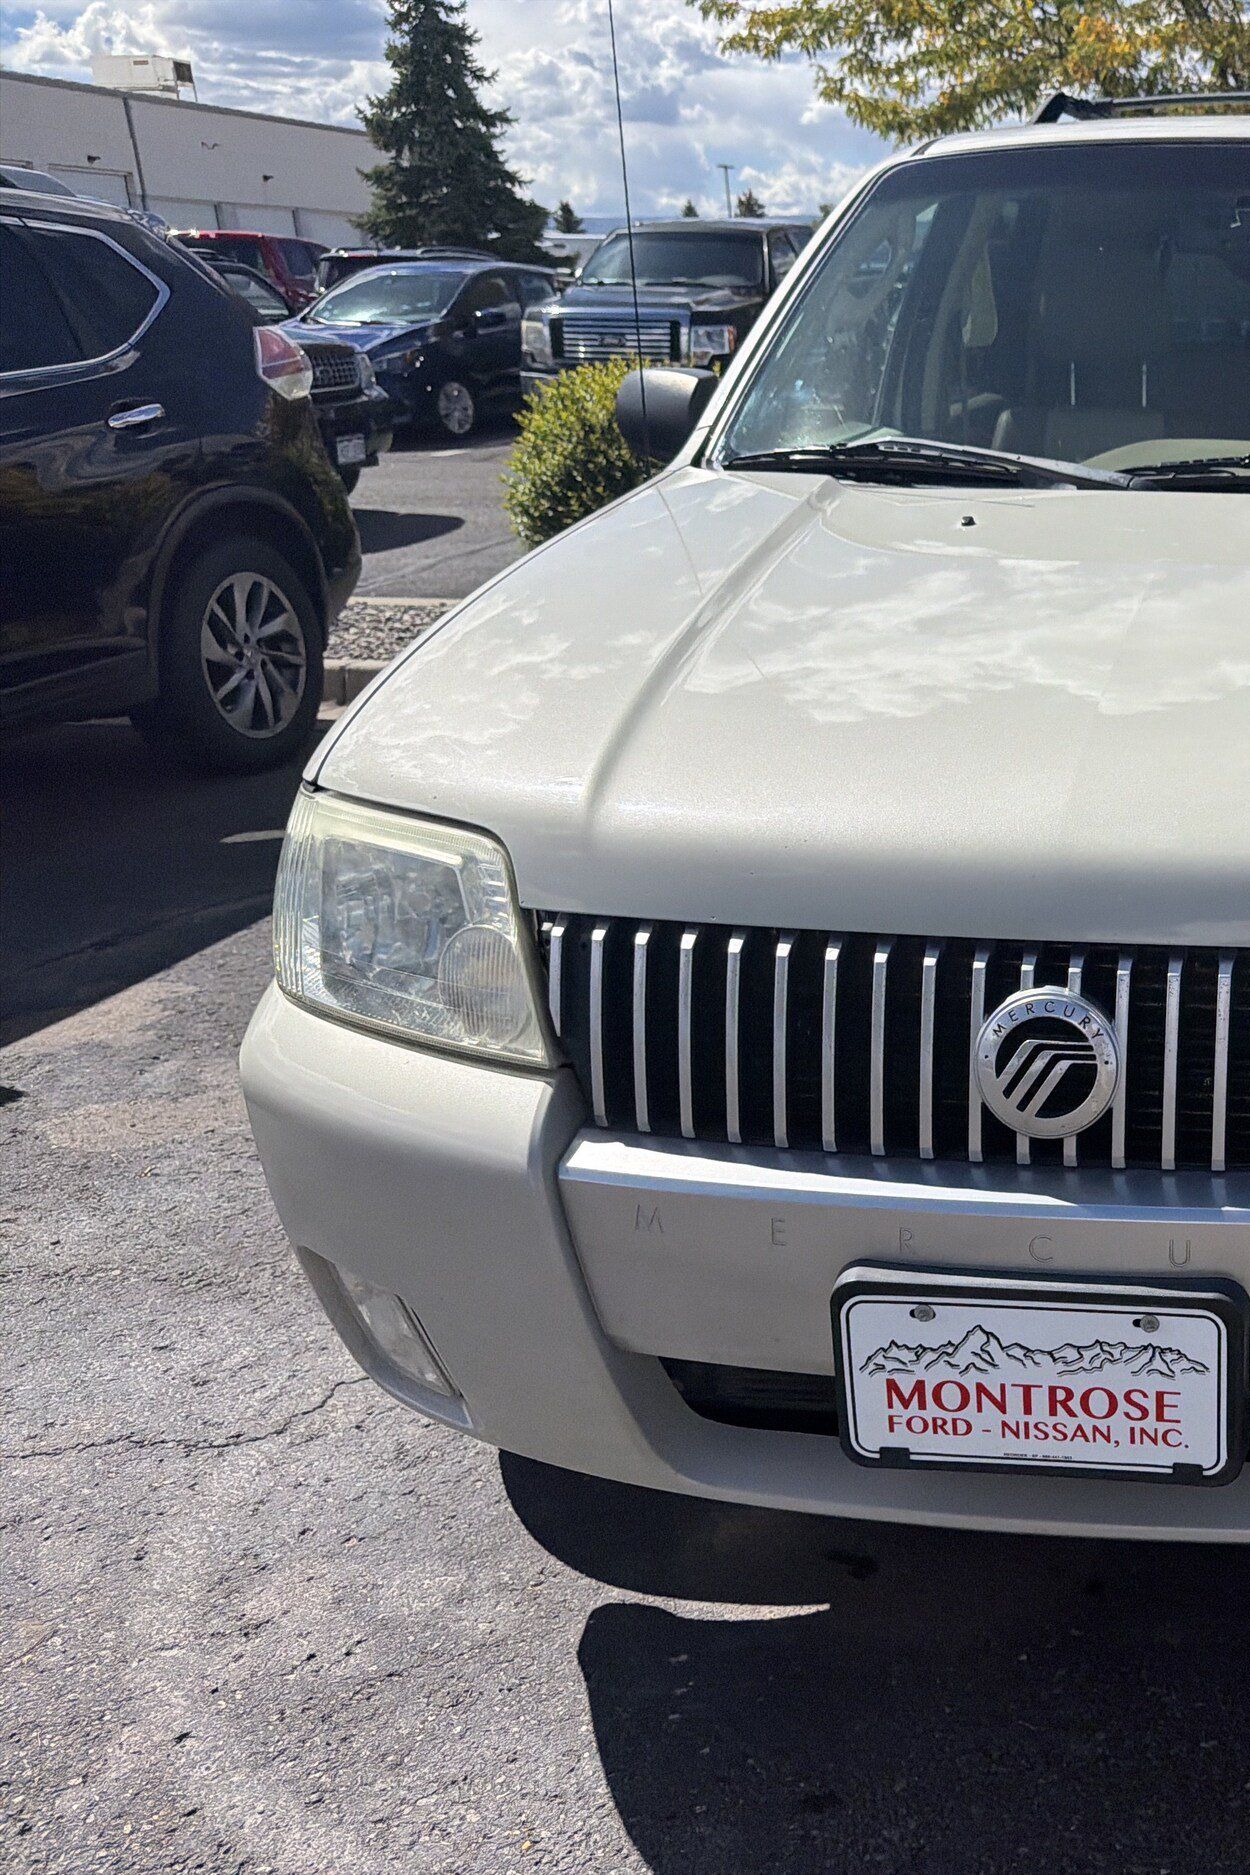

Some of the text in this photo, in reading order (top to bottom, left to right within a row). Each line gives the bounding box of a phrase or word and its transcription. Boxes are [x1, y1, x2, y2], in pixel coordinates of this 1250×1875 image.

[993, 1001, 1105, 1040] MERCURY
[886, 1378, 1182, 1424] MONTROSE
[887, 1414, 974, 1438] FORD
[1001, 1420, 1120, 1448] NISSAN,
[1129, 1427, 1190, 1449] INC.
